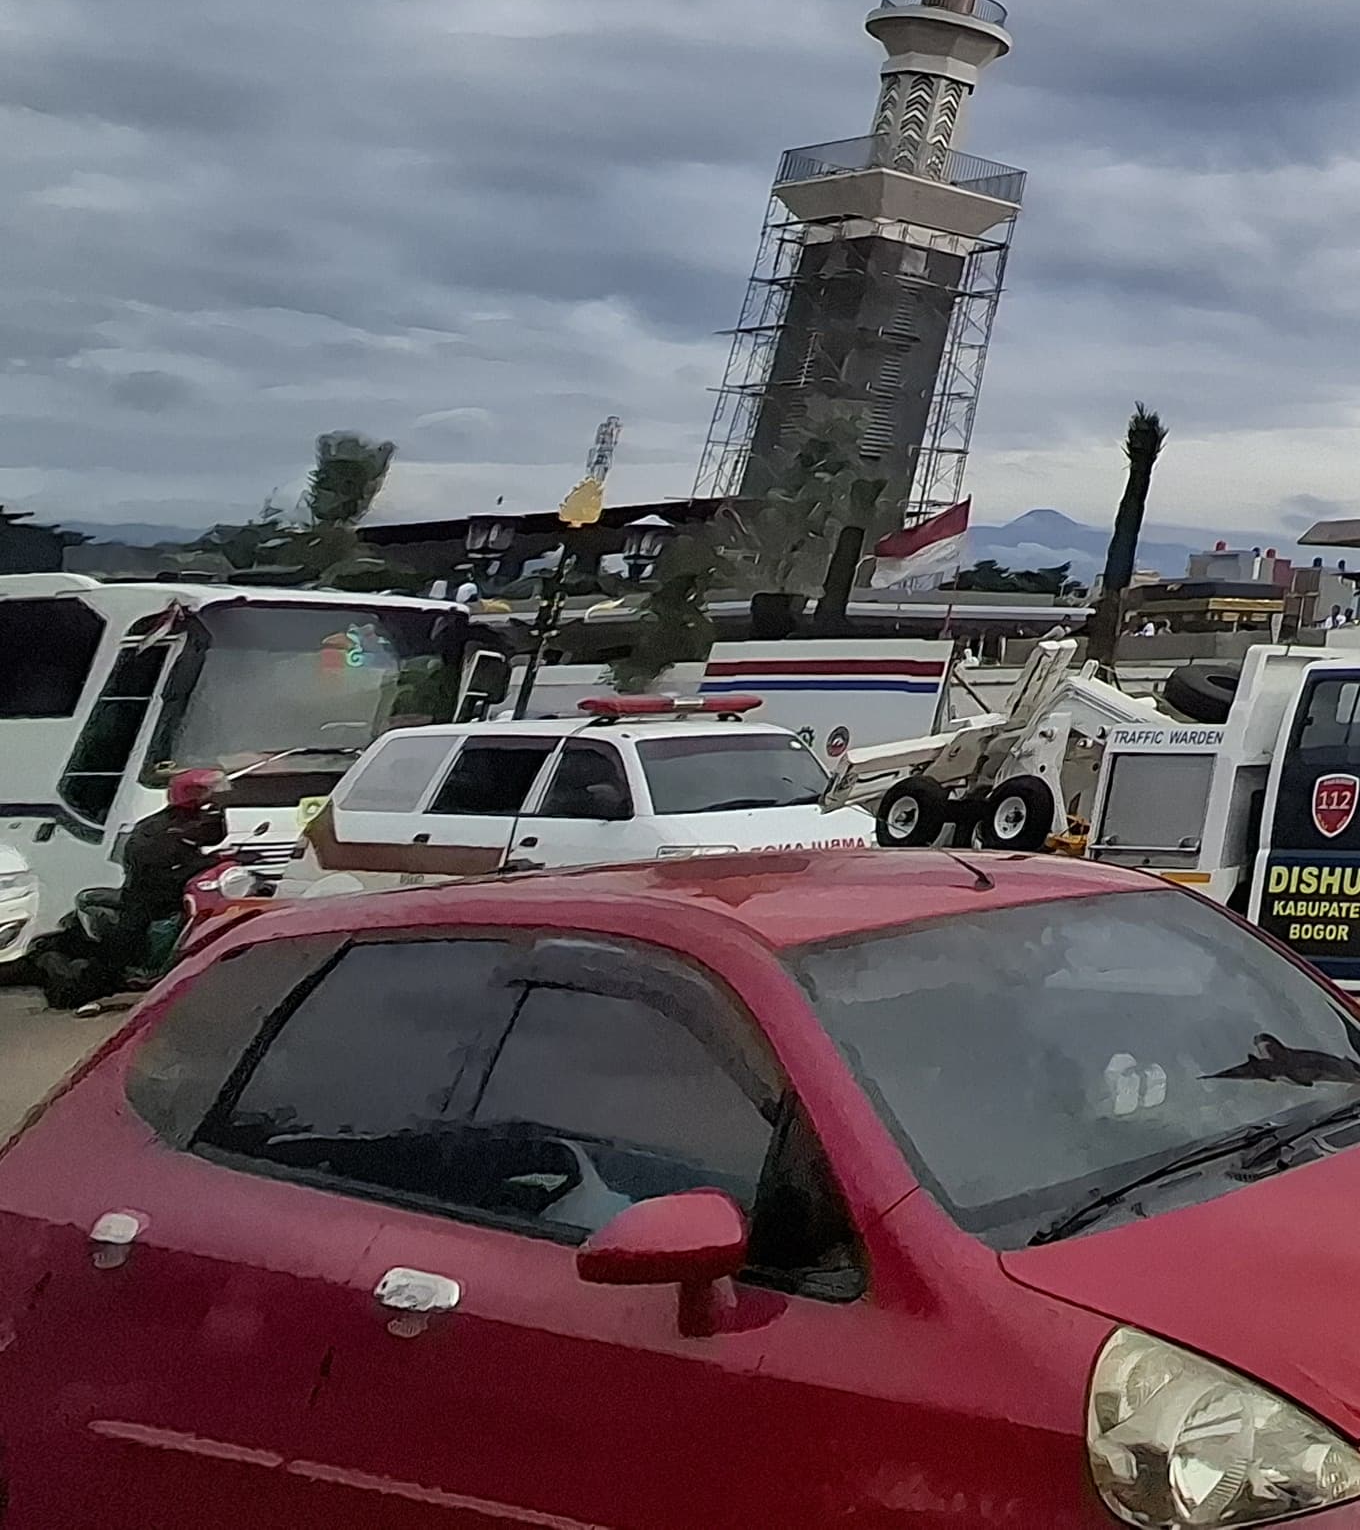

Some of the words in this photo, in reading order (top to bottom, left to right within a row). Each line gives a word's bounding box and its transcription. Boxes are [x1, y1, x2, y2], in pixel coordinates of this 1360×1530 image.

[1113, 730, 1164, 744] TRAFFIC
[1169, 730, 1224, 744] WARDEN
[1317, 791, 1352, 810] 112
[1289, 924, 1350, 941] BOGOR
